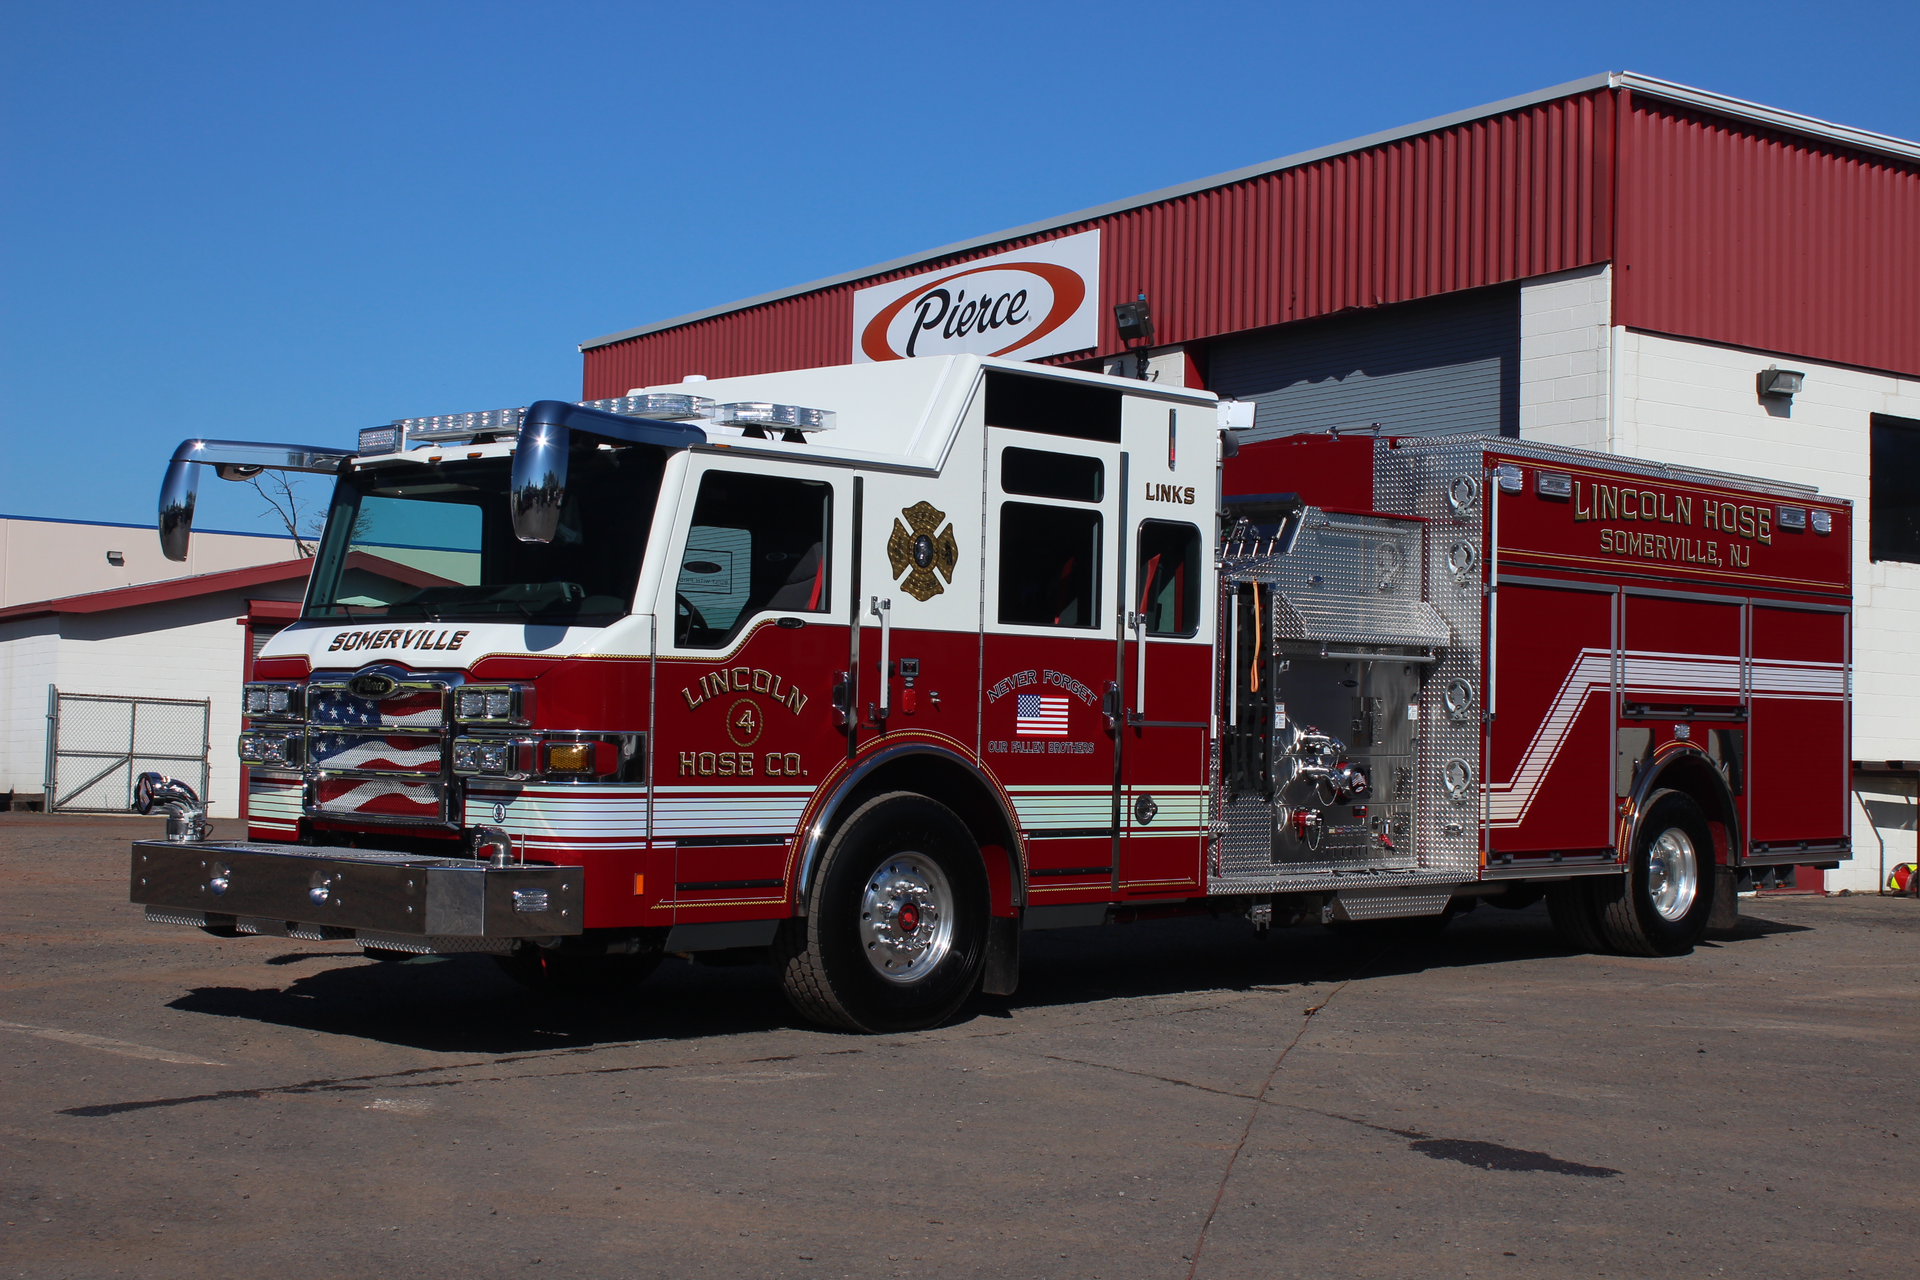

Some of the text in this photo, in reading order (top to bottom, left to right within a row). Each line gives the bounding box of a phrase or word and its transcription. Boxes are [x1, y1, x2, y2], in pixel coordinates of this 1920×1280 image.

[906, 289, 1029, 357] Pierce
[1146, 482, 1195, 504] LINKS
[1574, 481, 1771, 545] LINCOLN HOSE
[1600, 529, 1750, 568] SOMERVILLE, NJ
[328, 629, 470, 651] SOMERVILLE
[682, 667, 808, 716] LINCOLN
[987, 669, 1098, 706] NEVER FORGET
[735, 710, 755, 734] 4
[988, 741, 1095, 754] OUR FALLEN BROTHERS
[679, 751, 808, 776] HOSE CO.
